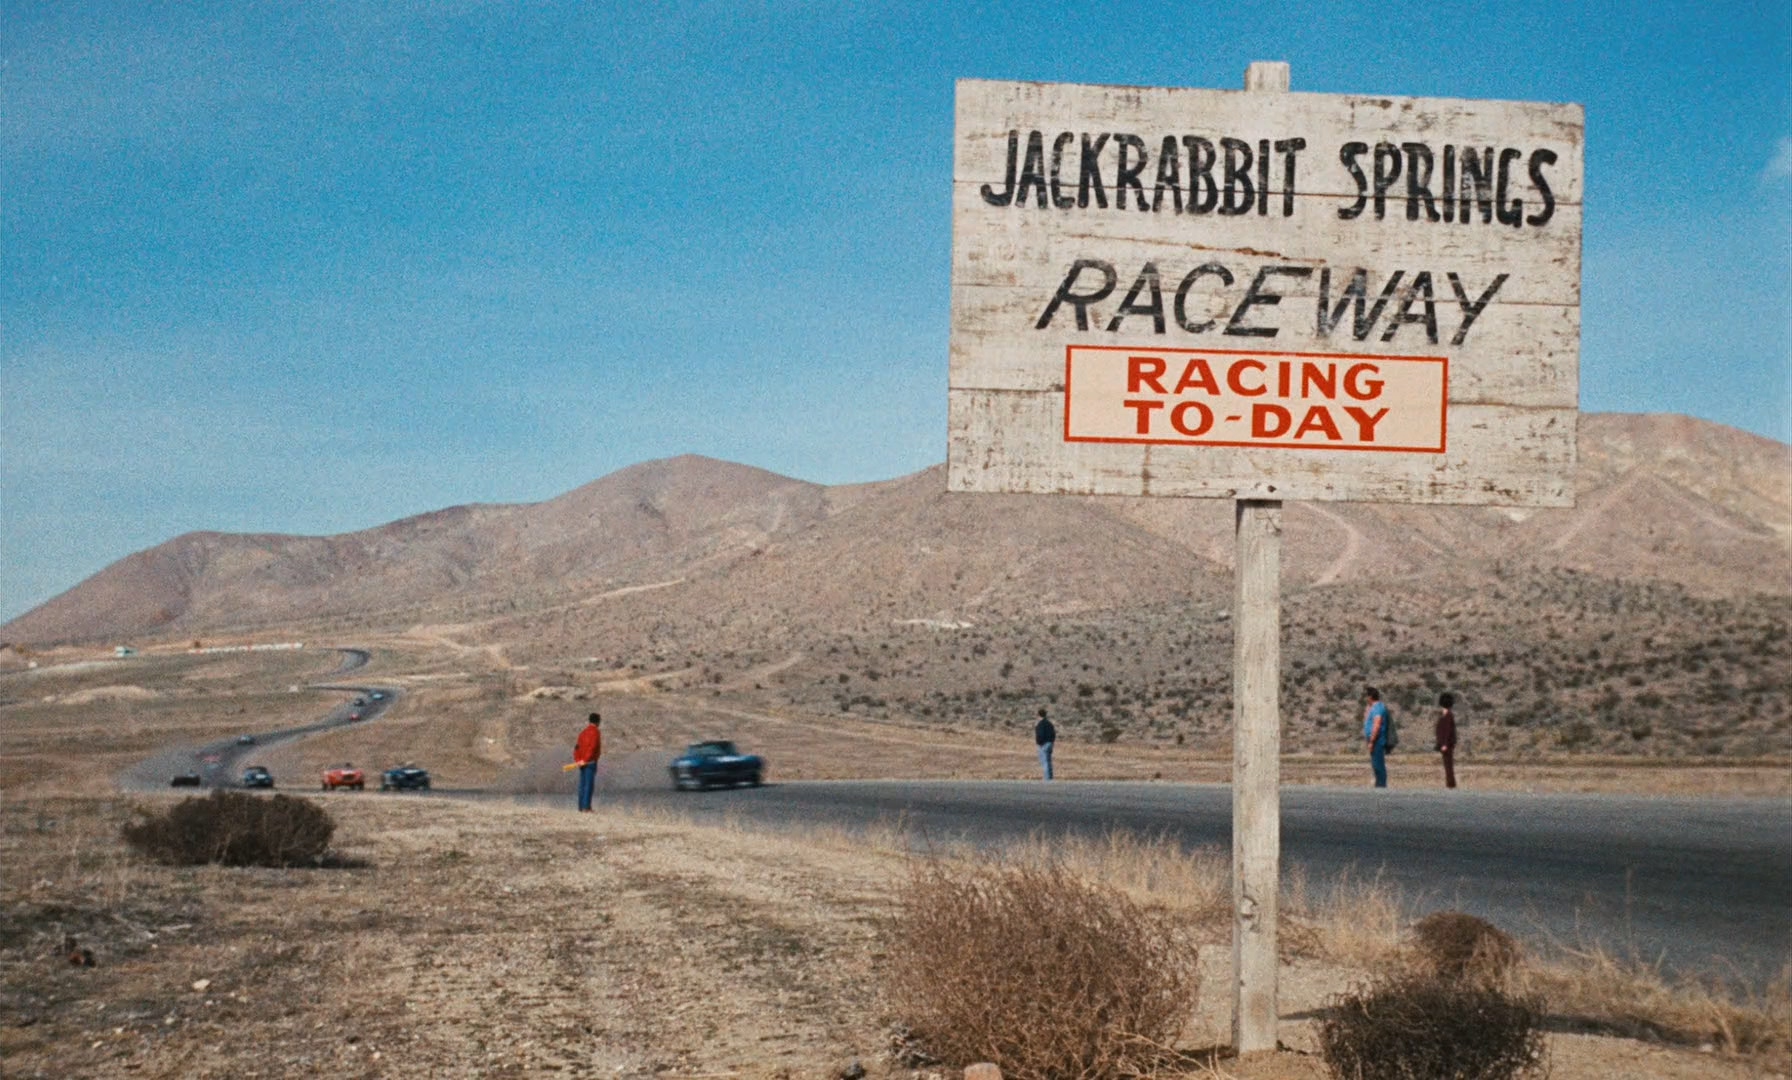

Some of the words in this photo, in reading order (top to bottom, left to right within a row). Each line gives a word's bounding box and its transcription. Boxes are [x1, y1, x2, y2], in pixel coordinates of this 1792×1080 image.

[980, 130, 1306, 217] JACKRABBIT
[1338, 141, 1557, 228] SPRINGS
[1035, 259, 1510, 346] RACEWAY
[1126, 357, 1385, 400] RACING
[1123, 400, 1390, 442] TO-DAY
